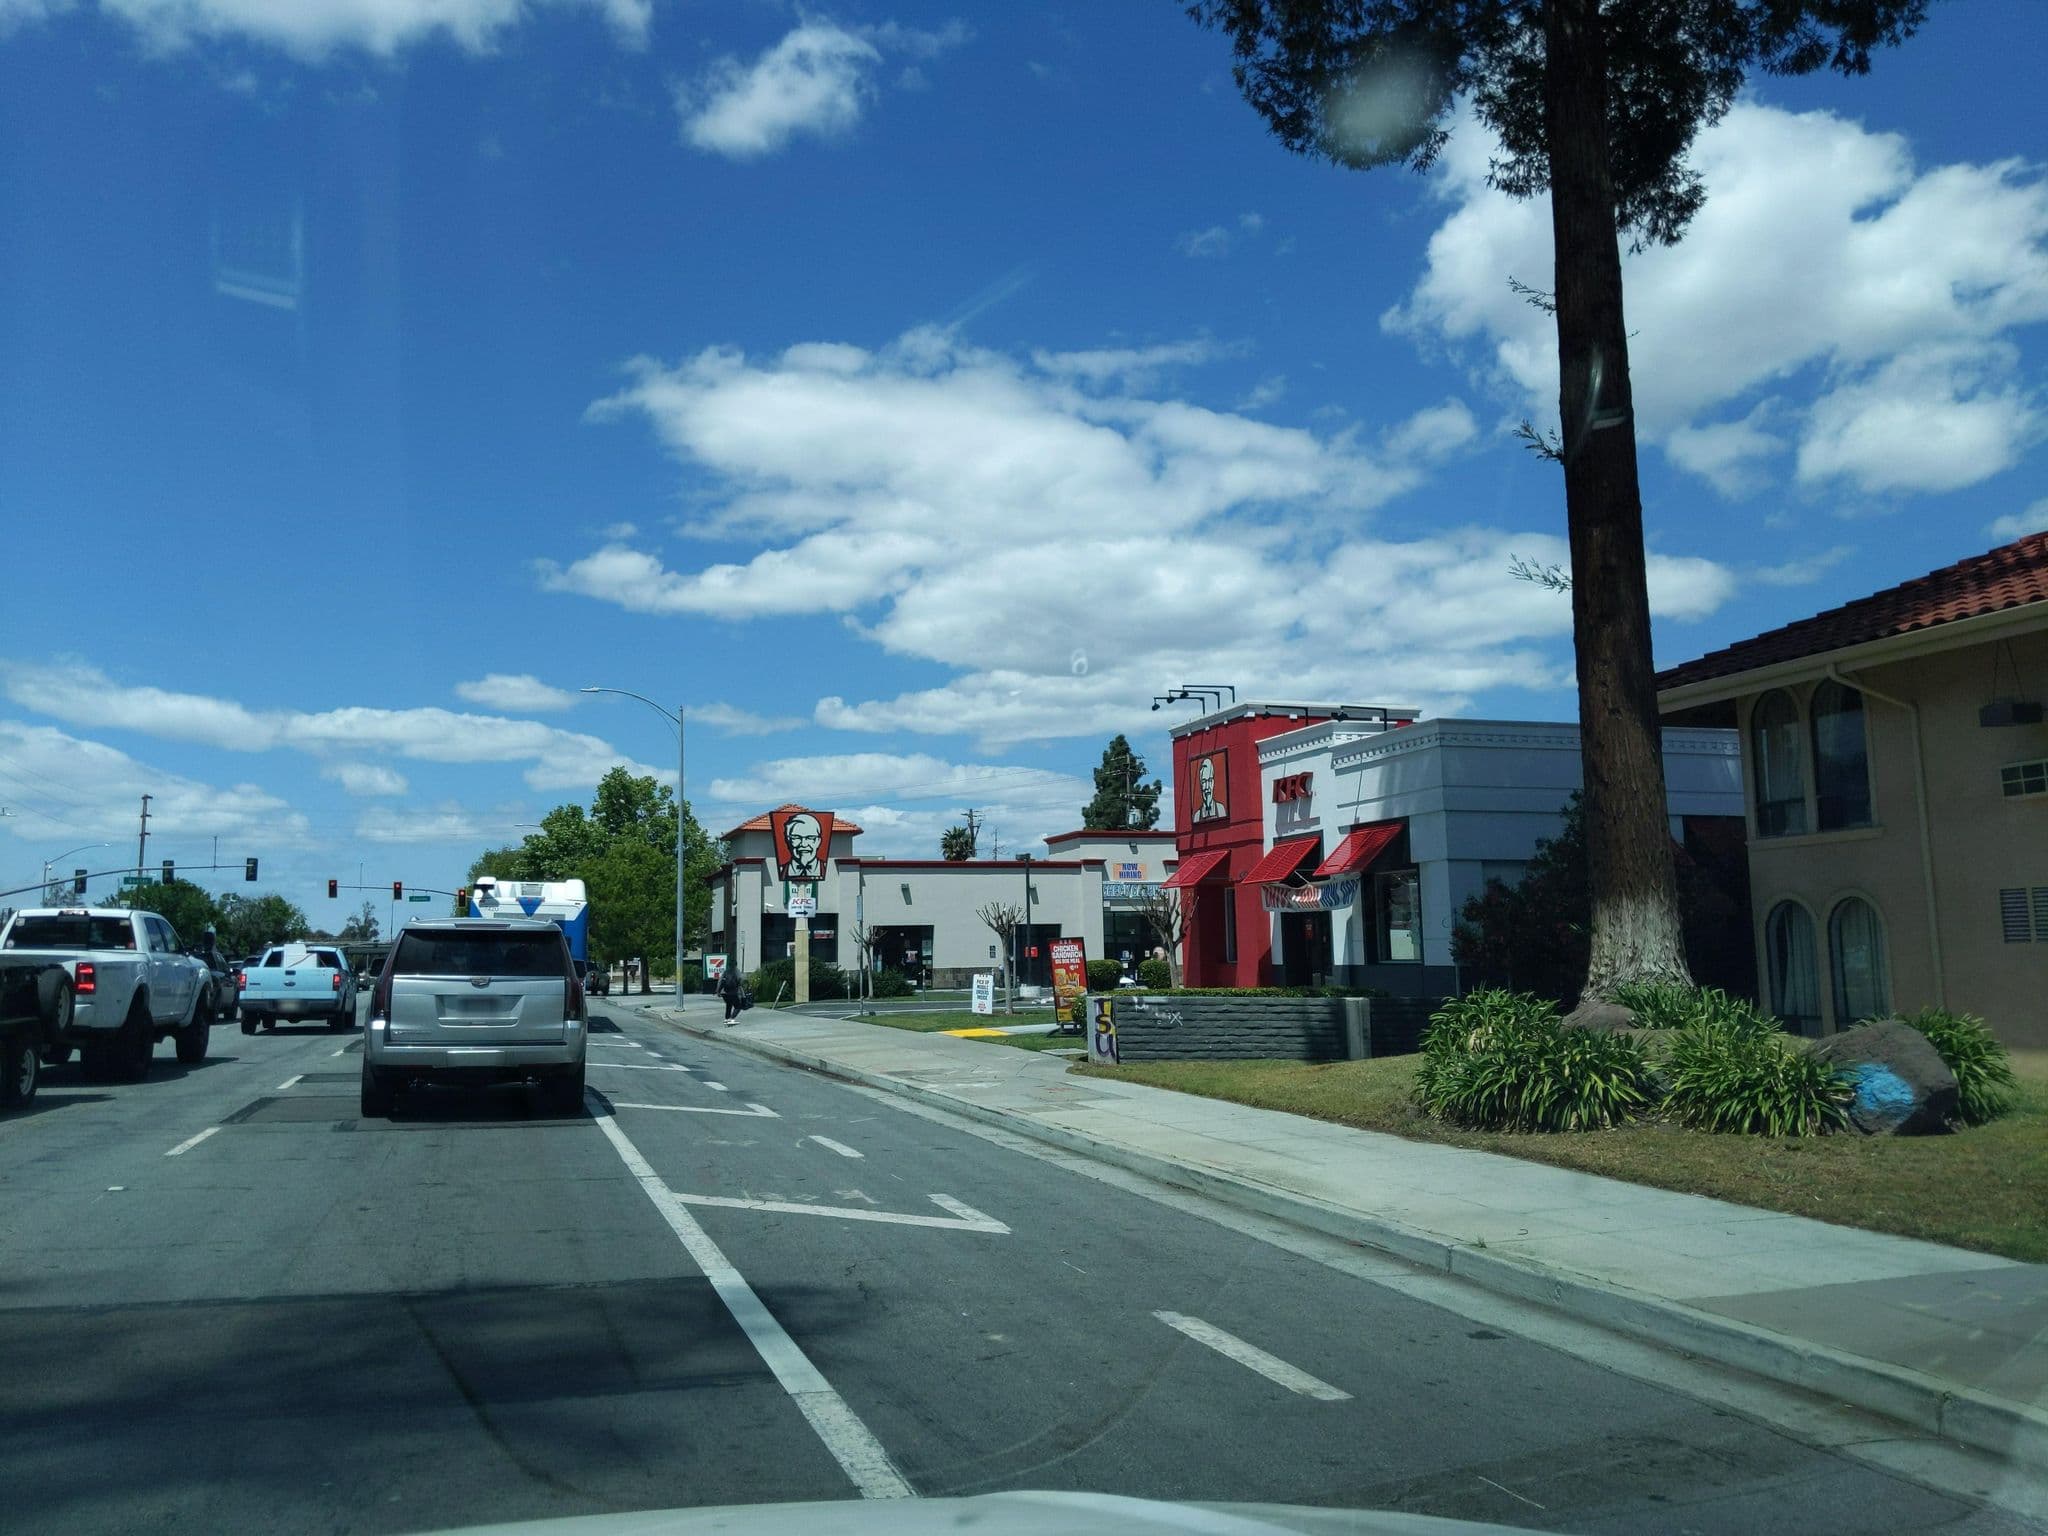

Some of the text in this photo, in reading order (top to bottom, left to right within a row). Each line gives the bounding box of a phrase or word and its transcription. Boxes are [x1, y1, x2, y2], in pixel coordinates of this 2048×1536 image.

[1272, 772, 1313, 803] KFC
[1119, 871, 1142, 879] HIRING
[1053, 944, 1079, 953] CHICKEN
[1051, 951, 1083, 960] SANDWICH
